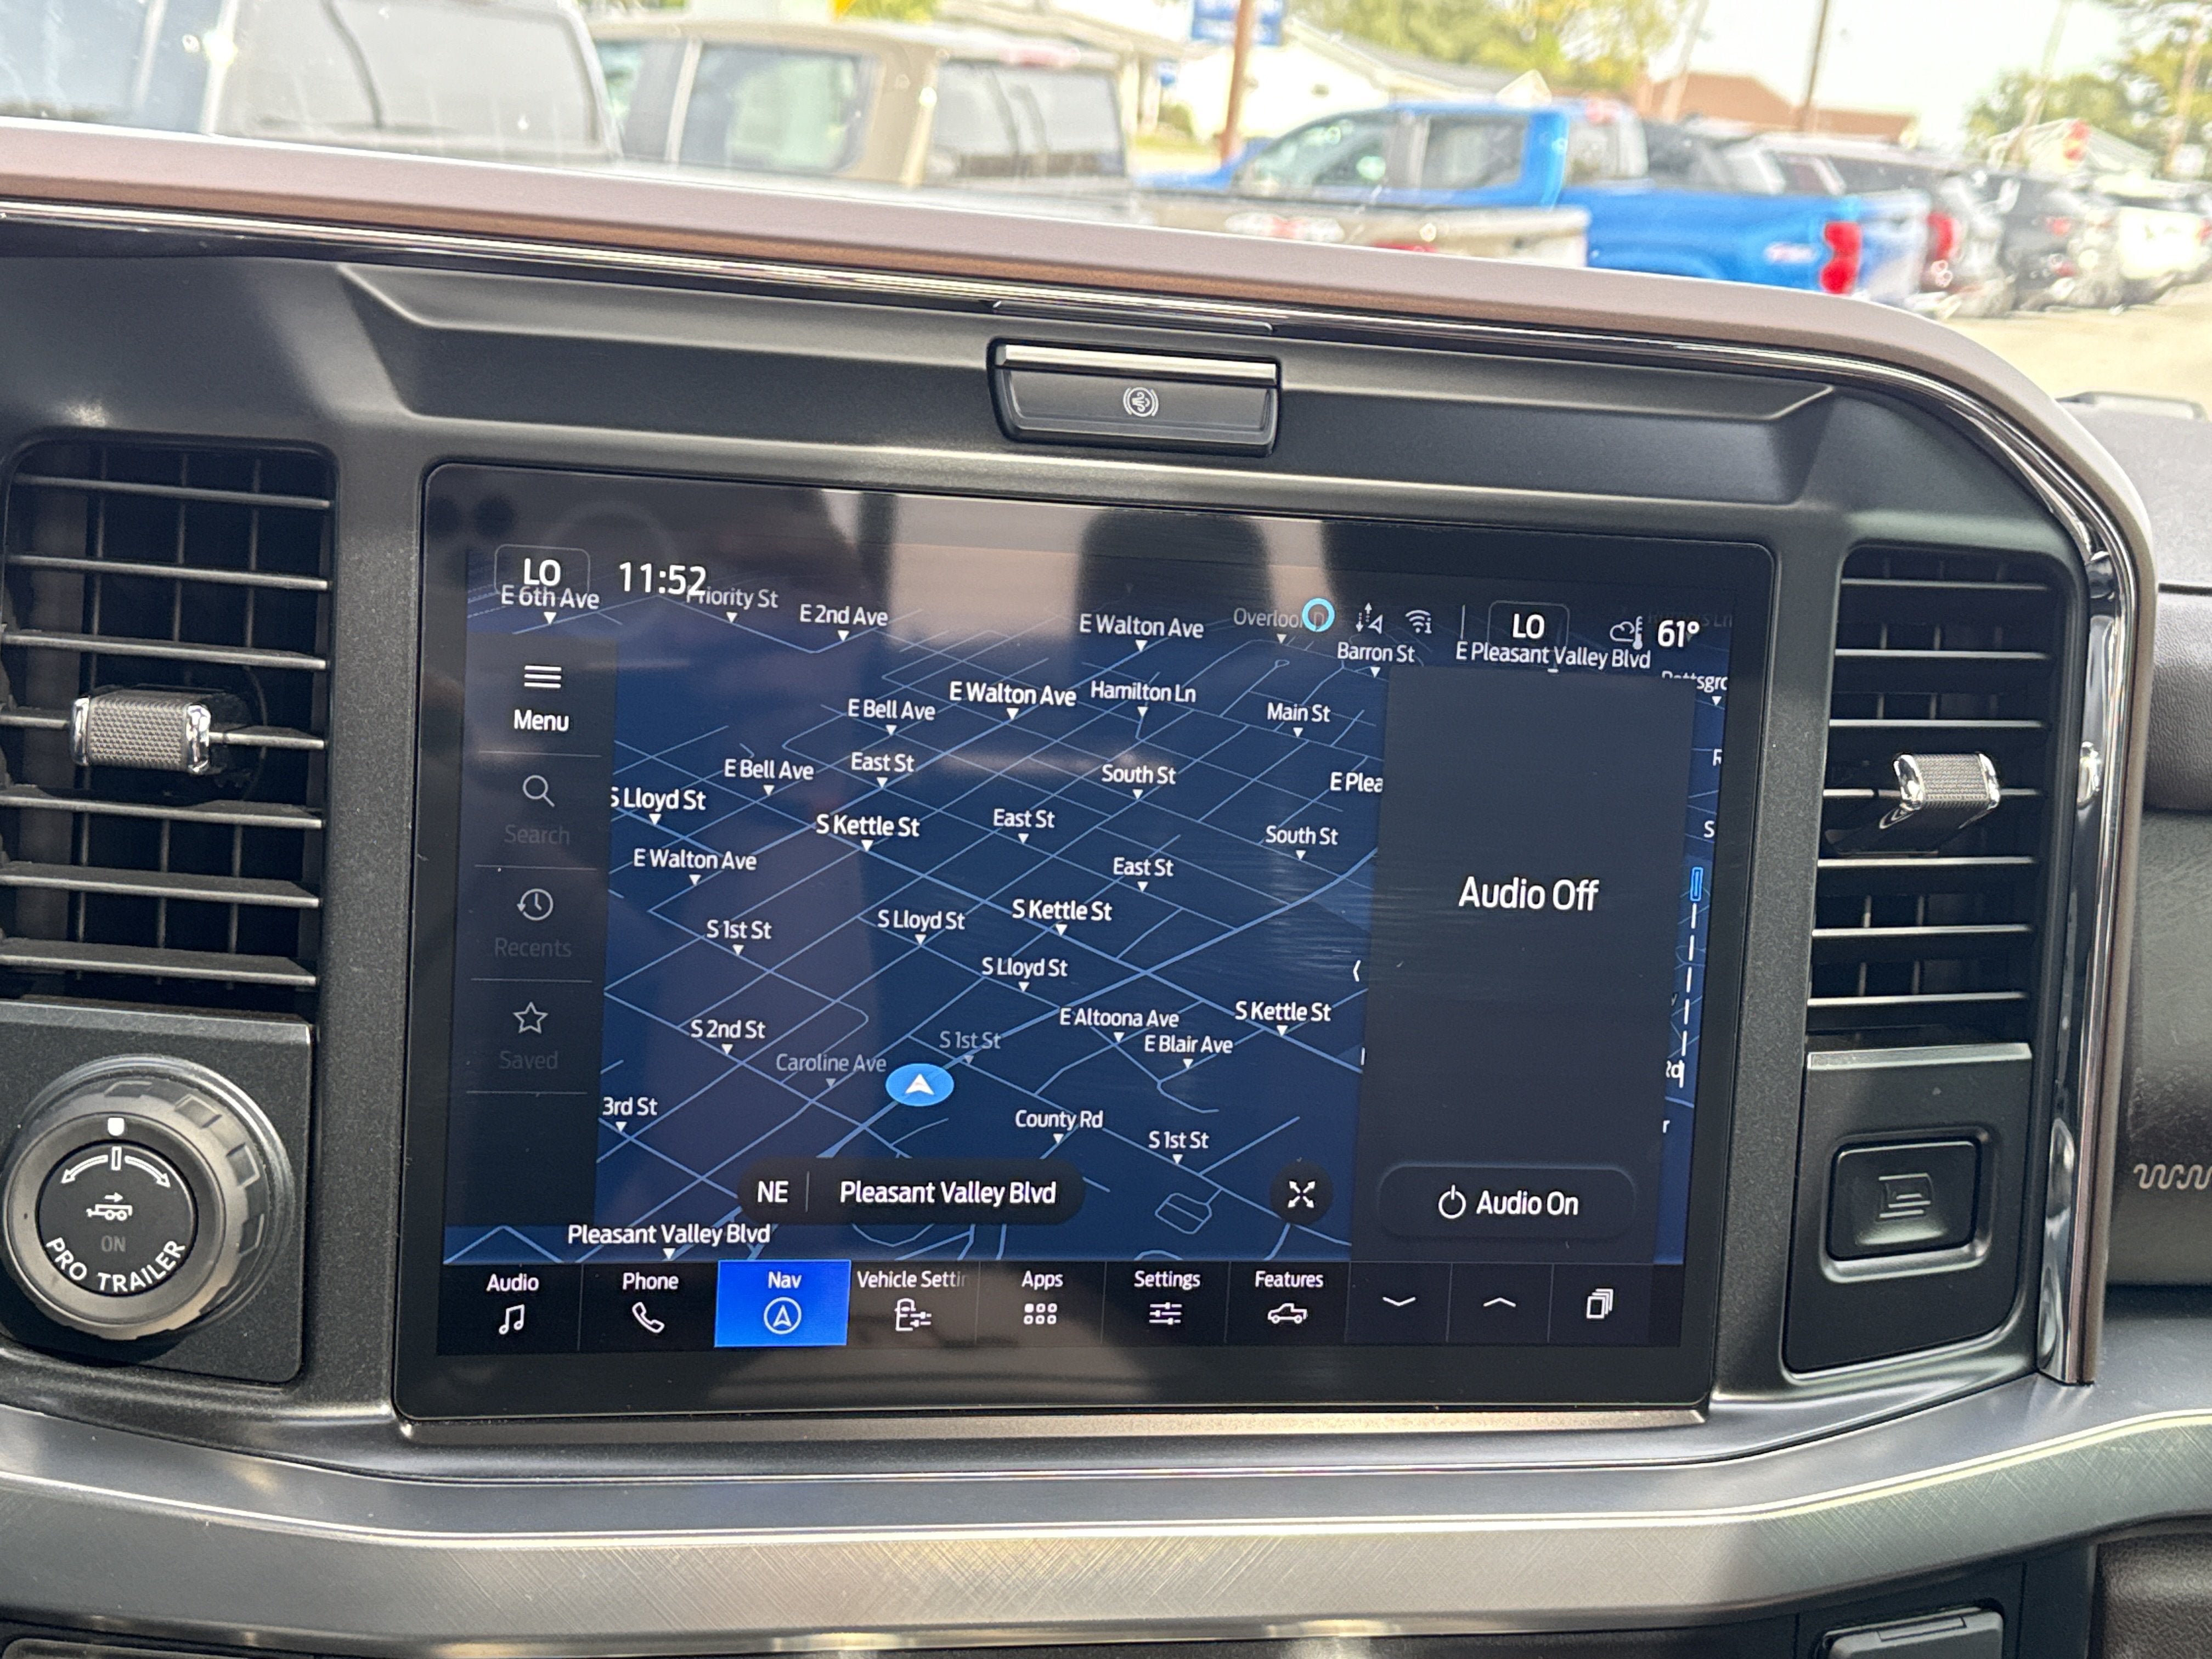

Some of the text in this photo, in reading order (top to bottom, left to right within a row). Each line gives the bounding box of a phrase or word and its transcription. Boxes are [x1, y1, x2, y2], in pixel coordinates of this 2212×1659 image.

[523, 558, 561, 586] LO
[619, 561, 707, 595] 11:52
[501, 585, 600, 610] E 6th Ave
[758, 589, 779, 608] St
[800, 604, 888, 626] E 2nd Ave
[1512, 613, 1545, 639] LO
[1080, 614, 1205, 639] E Walton Ave
[1657, 619, 1700, 648] 61°
[1338, 642, 1415, 663] Barron St
[1456, 641, 1651, 670] E Pleasant Valley Blvd
[950, 681, 1077, 707] E Walton Ave
[1091, 681, 1197, 703] Hamilton Ln
[514, 709, 570, 732] Menu
[848, 698, 936, 722] E Bell Ave
[1267, 702, 1331, 723] Main St
[725, 759, 814, 781] E Bell Ave
[851, 753, 915, 773] East St
[1102, 765, 1176, 785] South St
[1330, 771, 1343, 792] E
[624, 787, 679, 812] Lloyd
[683, 789, 707, 810] St
[816, 814, 920, 838] S Kettle St
[993, 809, 1055, 829] East St
[504, 825, 571, 845] Search
[1266, 825, 1339, 847] South St
[634, 849, 757, 871] E Walton Ave
[1113, 857, 1174, 877] East St
[1458, 876, 1600, 912] Audio Off
[1012, 899, 1113, 922] S Kettle St
[707, 919, 772, 940] S 1st St
[878, 910, 966, 934] S Lloyd St
[494, 938, 572, 959] Recents
[981, 957, 1068, 980] S Lloyd St
[1060, 1008, 1180, 1028] E Altoona Ave
[1235, 1001, 1331, 1023] S Kettle St
[691, 1019, 766, 1040] S 2nd St
[940, 1031, 1001, 1050] S 1st St
[1144, 1035, 1233, 1055] E Blair Ave
[499, 1051, 558, 1071] Saved
[776, 1053, 887, 1073] Caroline Ave
[602, 1097, 658, 1116] 3rd St
[1015, 1109, 1104, 1131] County Rd
[1149, 1131, 1209, 1150] S 1st St
[758, 1180, 789, 1203] NE
[840, 1180, 1057, 1207] Pleasant Valley Blvd
[1476, 1190, 1579, 1216] Audio On
[101, 1235, 126, 1252] ON
[568, 1224, 771, 1248] Pleasant Valley Blvd
[46, 1237, 186, 1293] PRO TRAILER
[486, 1273, 539, 1293] Audio
[622, 1272, 679, 1291] Phone
[768, 1272, 802, 1290] Nav
[857, 1271, 917, 1288] Vehicle
[1022, 1271, 1063, 1290] Apps
[1134, 1270, 1201, 1290] Settings
[1255, 1271, 1324, 1290] Features
